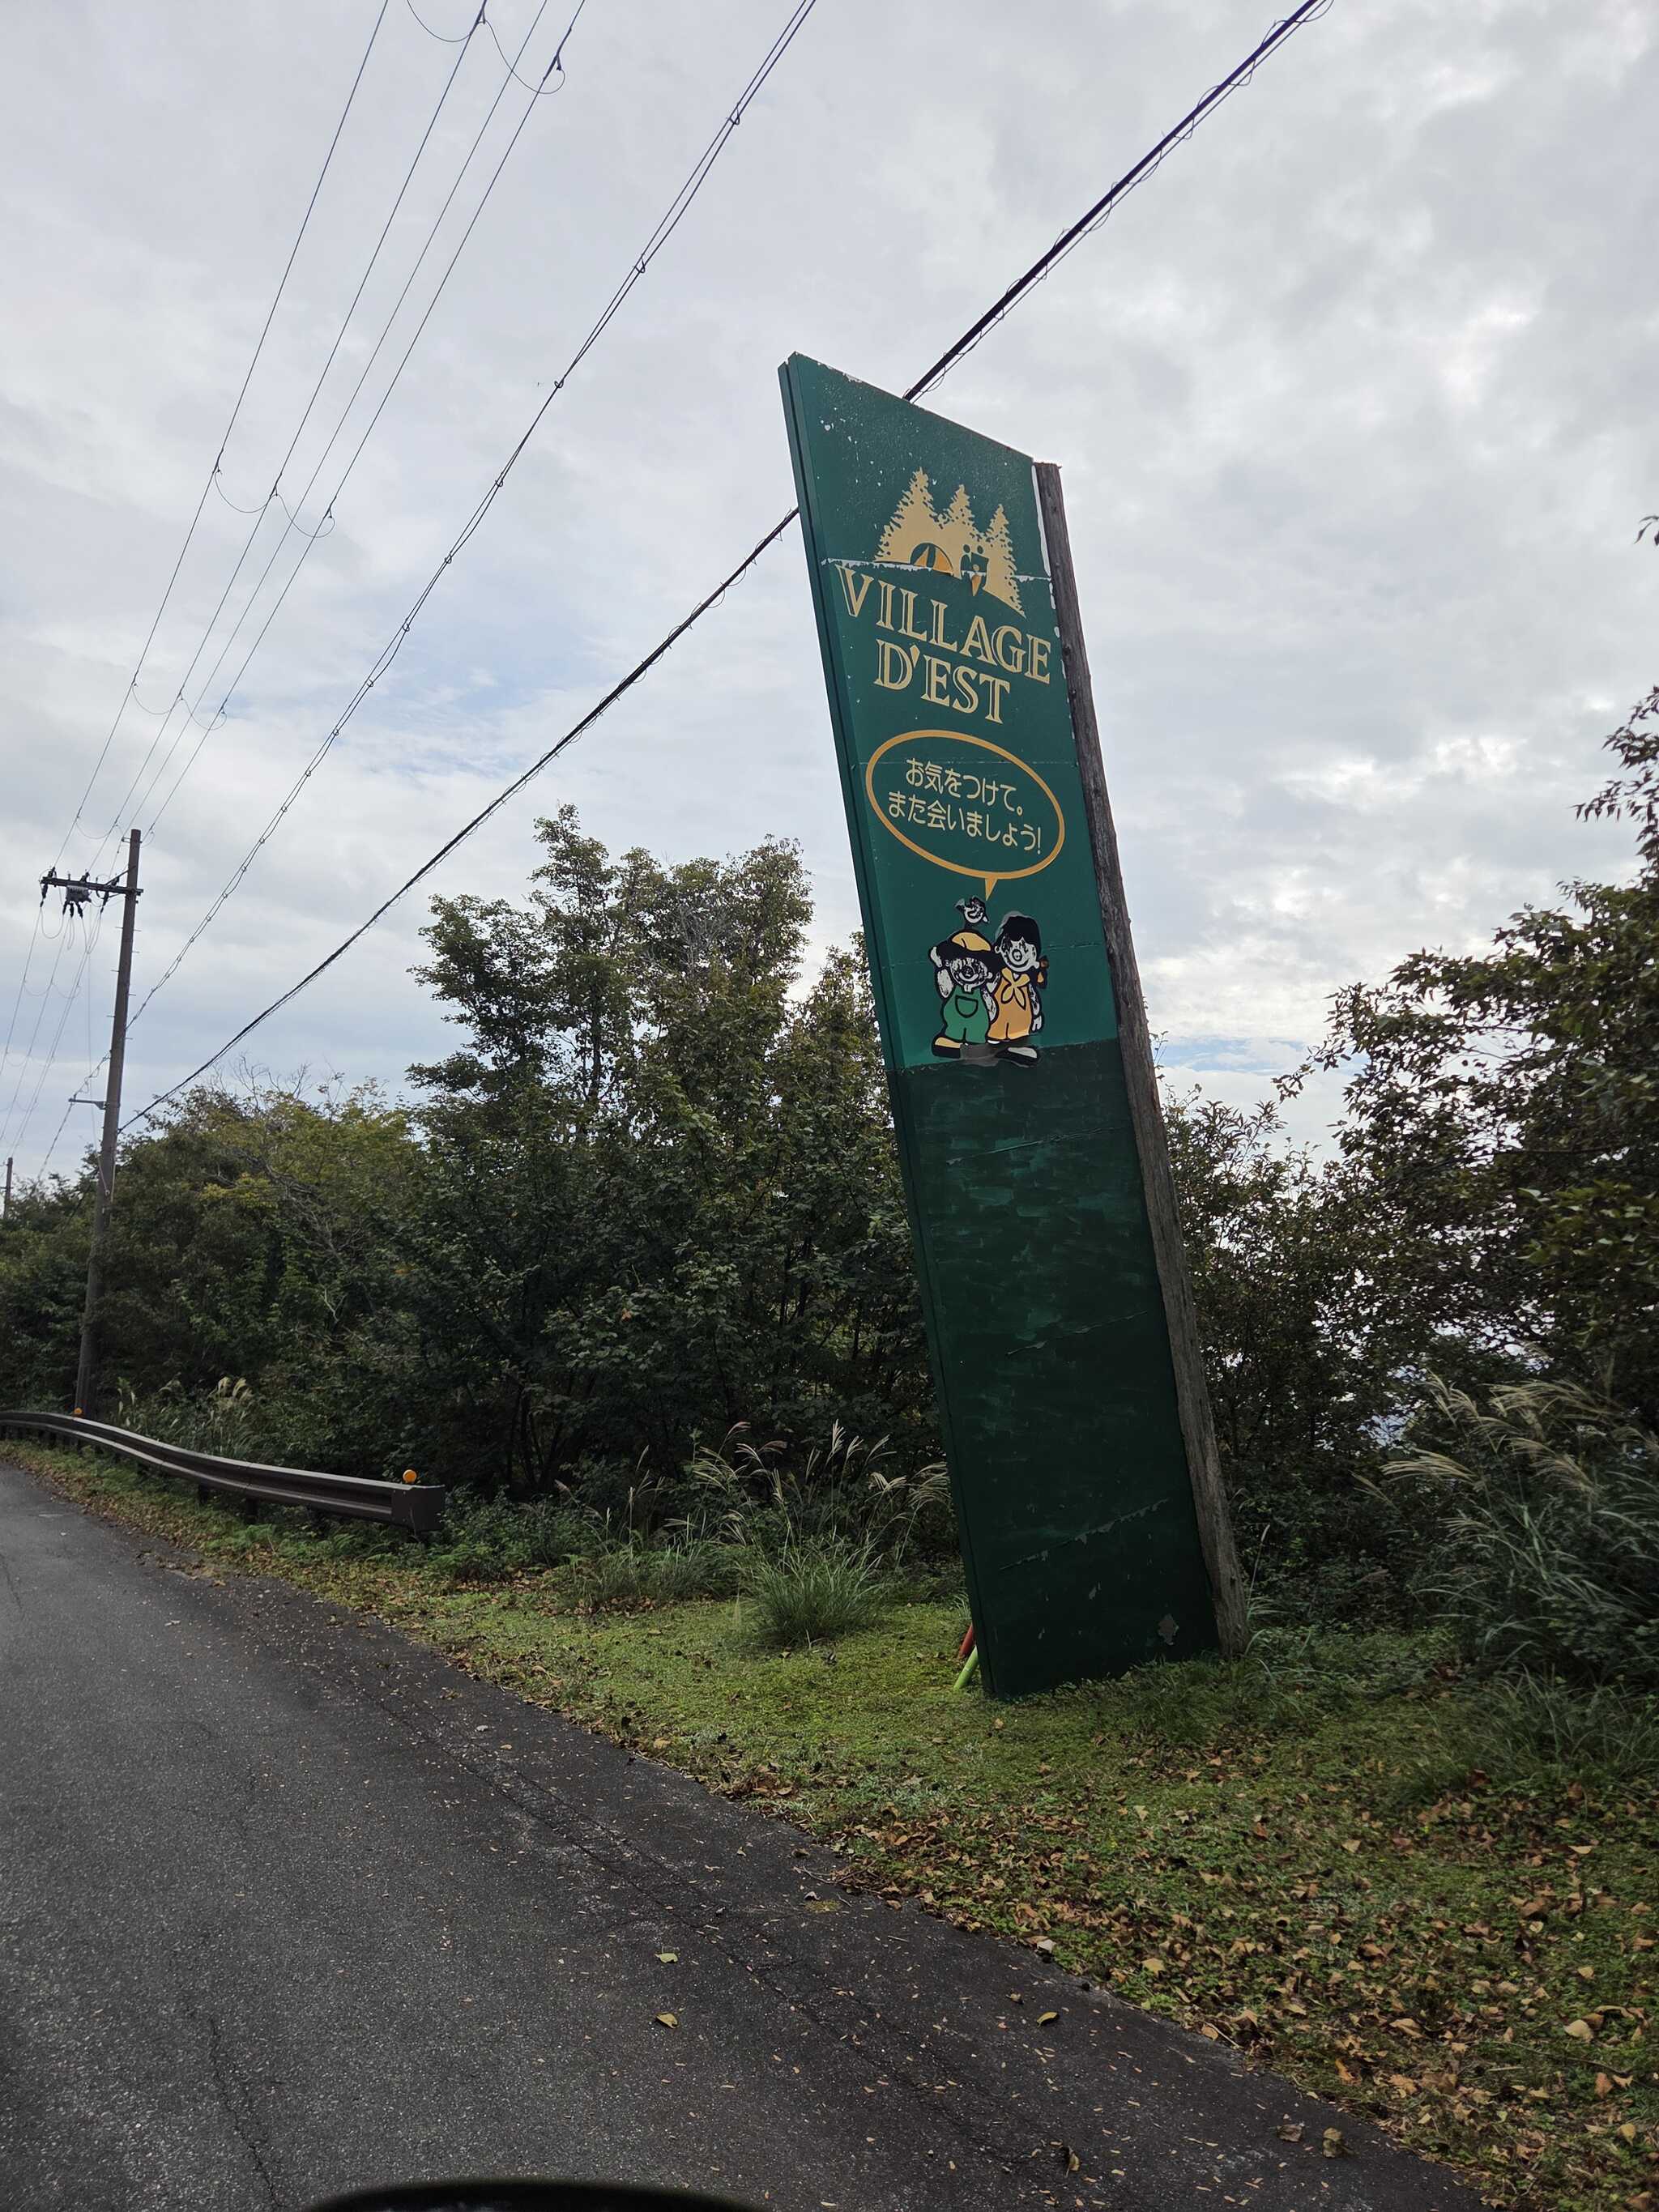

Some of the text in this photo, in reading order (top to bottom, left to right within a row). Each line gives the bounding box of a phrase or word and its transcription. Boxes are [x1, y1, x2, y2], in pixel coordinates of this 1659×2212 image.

[835, 565, 1051, 684] VILLAGE
[873, 638, 1010, 724] D'EST
[889, 791, 1041, 855] また会いましょう!
[906, 758, 1023, 816] お気をつけて。
